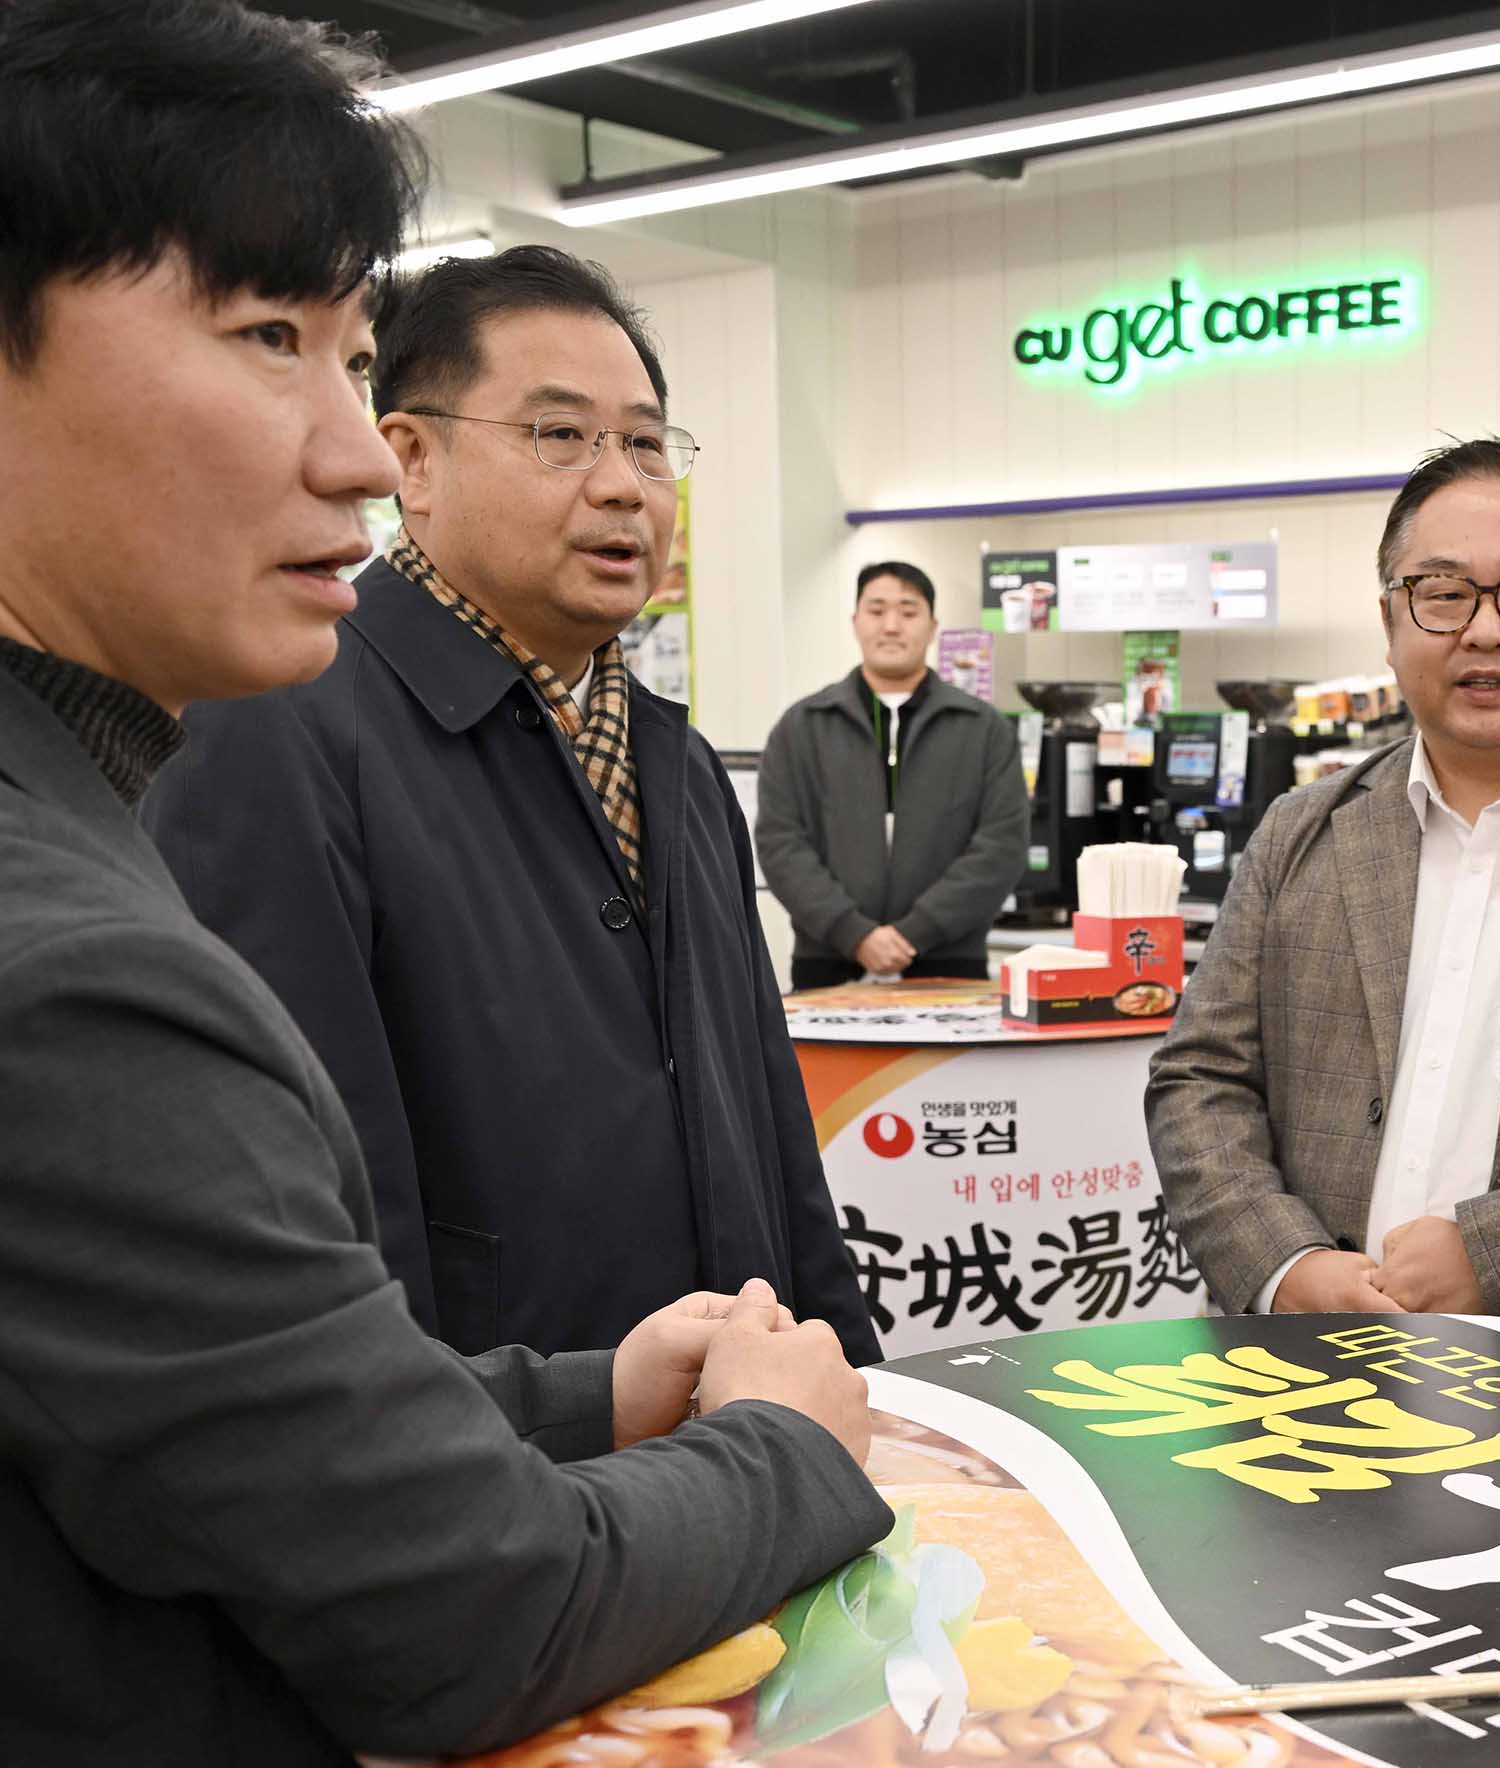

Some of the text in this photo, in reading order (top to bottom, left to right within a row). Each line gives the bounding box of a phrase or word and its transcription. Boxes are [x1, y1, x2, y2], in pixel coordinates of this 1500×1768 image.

[1082, 279, 1194, 384] get
[1203, 280, 1400, 343] COFFEE
[1125, 928, 1156, 975] 辛
[922, 1099, 1017, 1117] 인생을 맛있게
[922, 1120, 1018, 1157] 농심
[954, 1160, 1143, 1204] 내 입에 안성맞춤
